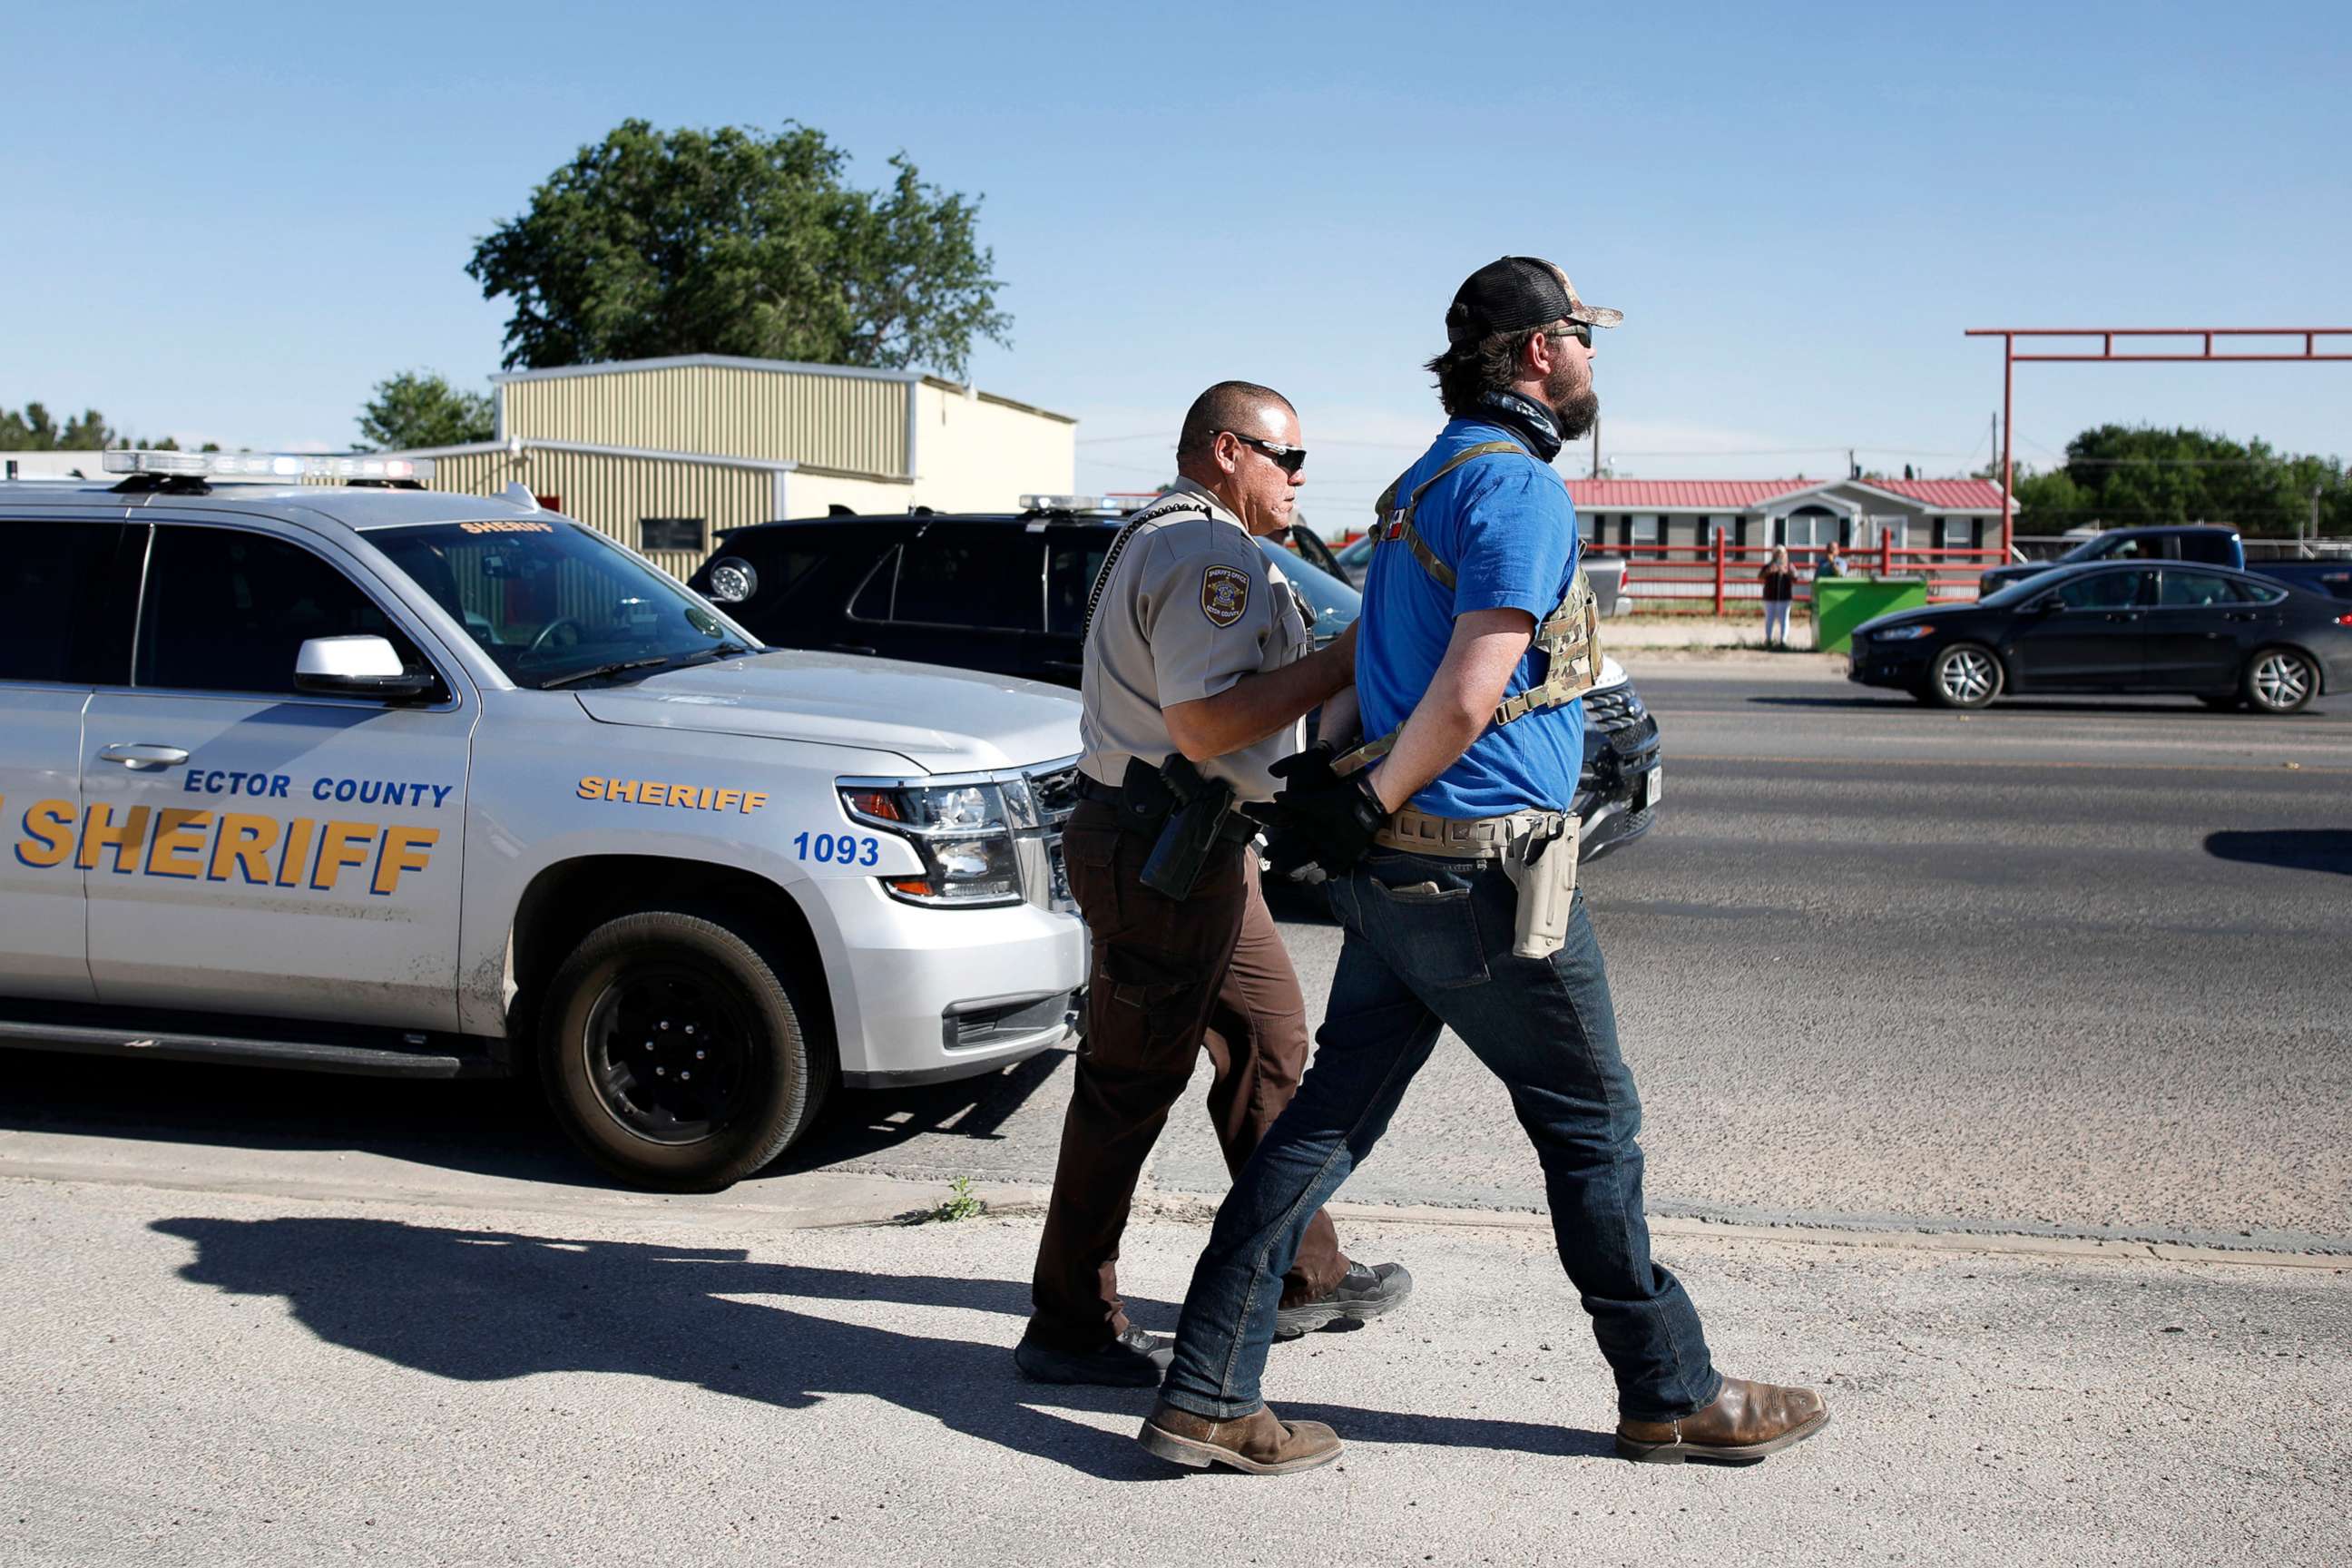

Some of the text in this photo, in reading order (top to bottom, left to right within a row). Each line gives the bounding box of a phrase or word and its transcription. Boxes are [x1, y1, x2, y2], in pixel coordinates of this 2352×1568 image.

[459, 522, 553, 534] SHERIFF
[1230, 572, 1247, 583] OFFICE
[1220, 610, 1240, 618] COUNTY
[183, 770, 452, 808] ECTOR COUNTY
[576, 776, 769, 814] SHERIFF
[15, 799, 440, 895] SHERIFF
[793, 832, 879, 867] 1093
